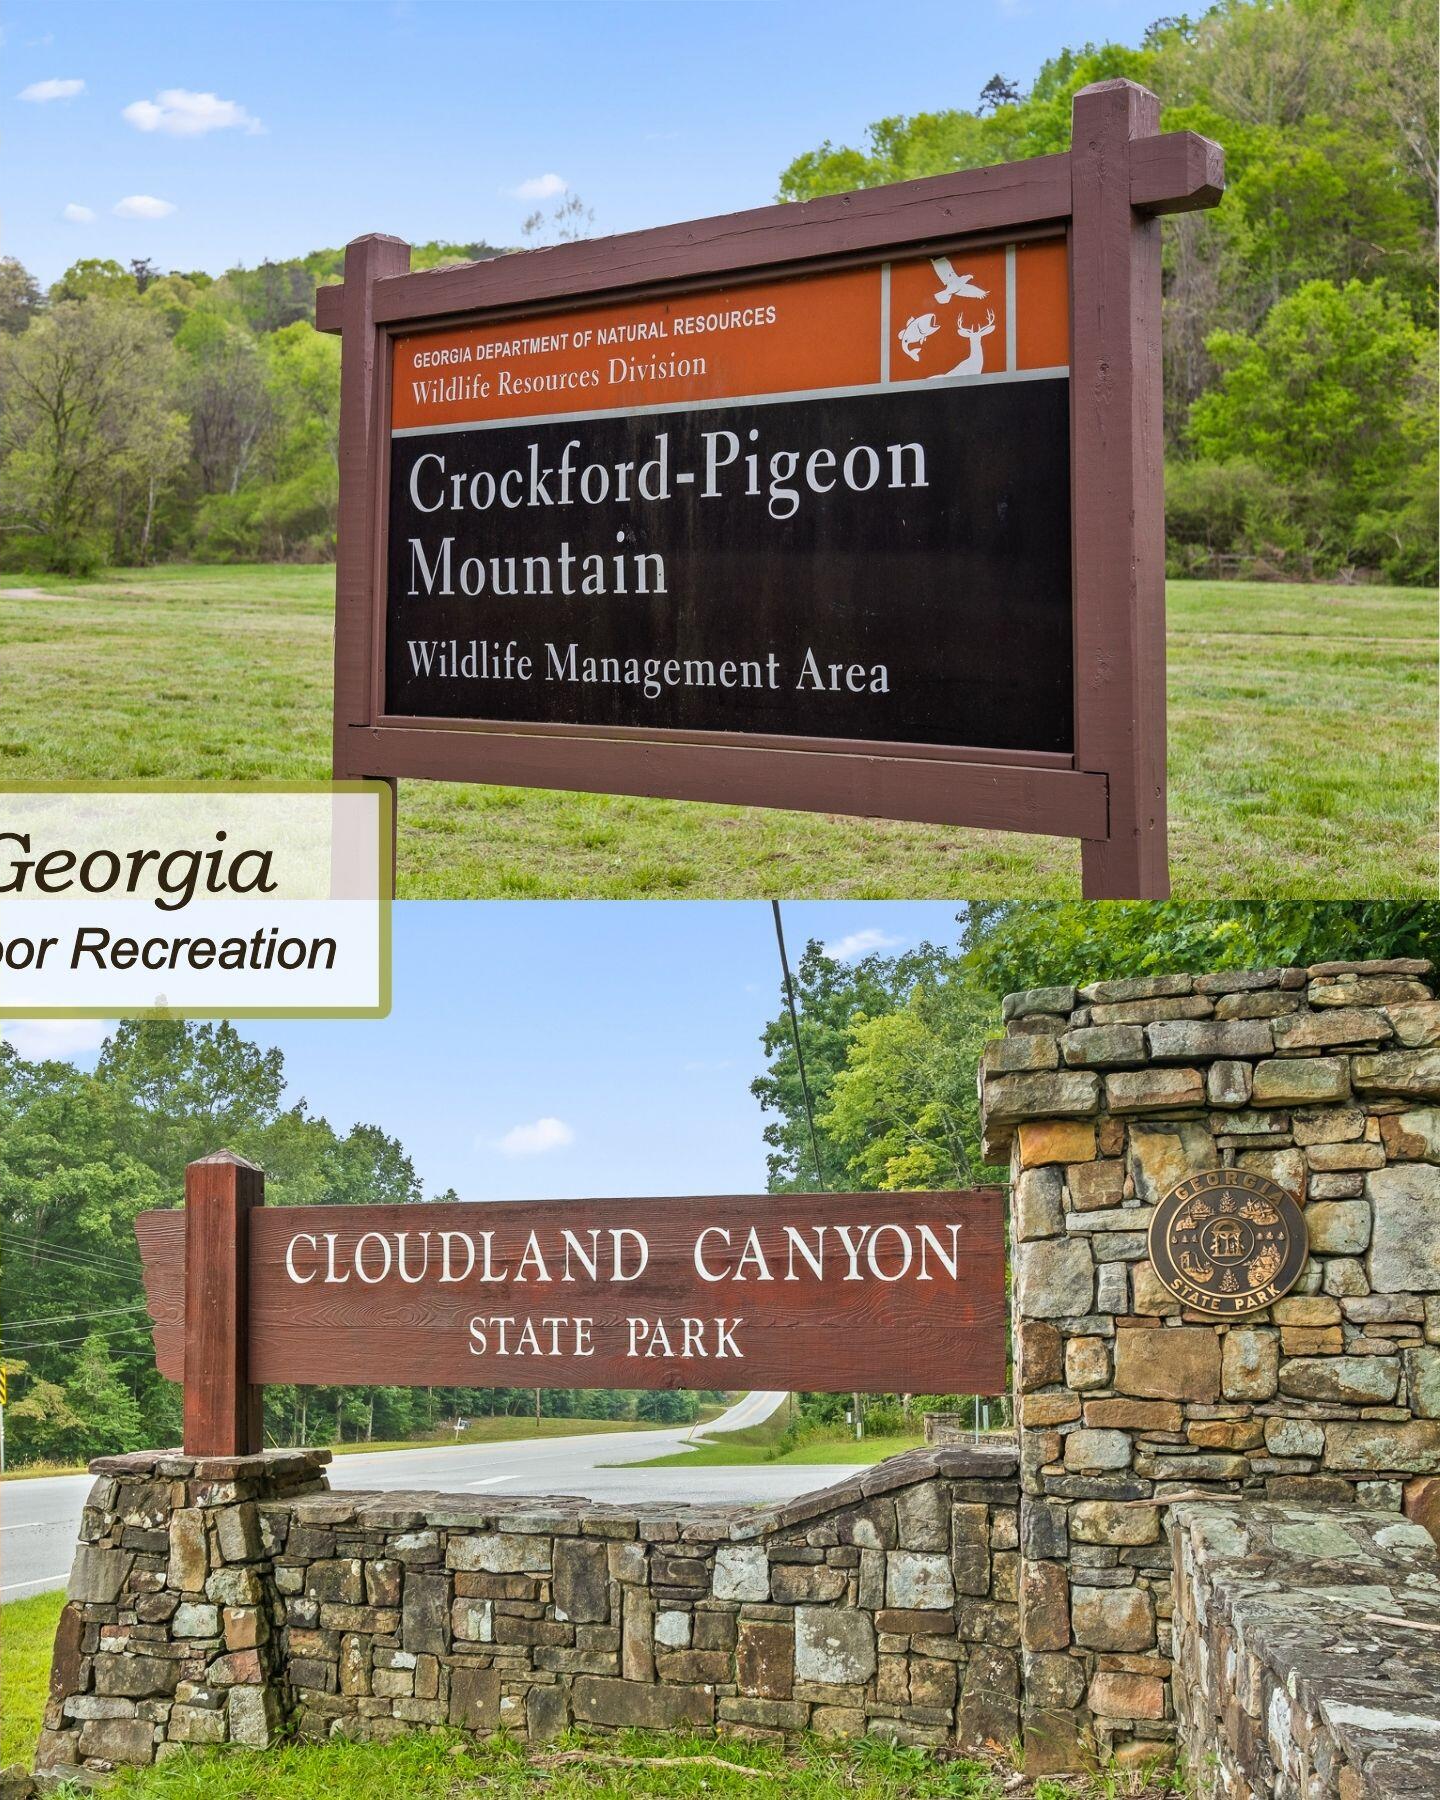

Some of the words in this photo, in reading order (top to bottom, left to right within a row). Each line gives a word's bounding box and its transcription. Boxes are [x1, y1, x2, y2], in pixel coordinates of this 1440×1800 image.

[413, 347, 472, 369] GEORGIA
[476, 332, 568, 362] DEPARTMENT
[572, 330, 592, 349] OF
[596, 319, 668, 346] NATURAL
[673, 305, 777, 336] RESOURCES
[412, 372, 491, 405] Wildlife
[498, 368, 600, 396] Resources
[608, 353, 707, 385] Division
[409, 428, 930, 520] Crockford-Pigeon
[407, 530, 668, 596] Mountain
[407, 640, 533, 681] Wildlife
[545, 642, 780, 699] Management
[796, 646, 891, 693] Area
[1174, 1171, 1286, 1206] GEORGIA
[285, 1228, 650, 1284] CLOUDLAND
[693, 1224, 963, 1283] CANYON
[1170, 1278, 1221, 1311] STATE
[1235, 1283, 1281, 1311] PARK
[468, 1317, 596, 1357] STATE
[626, 1317, 744, 1359] PARK
